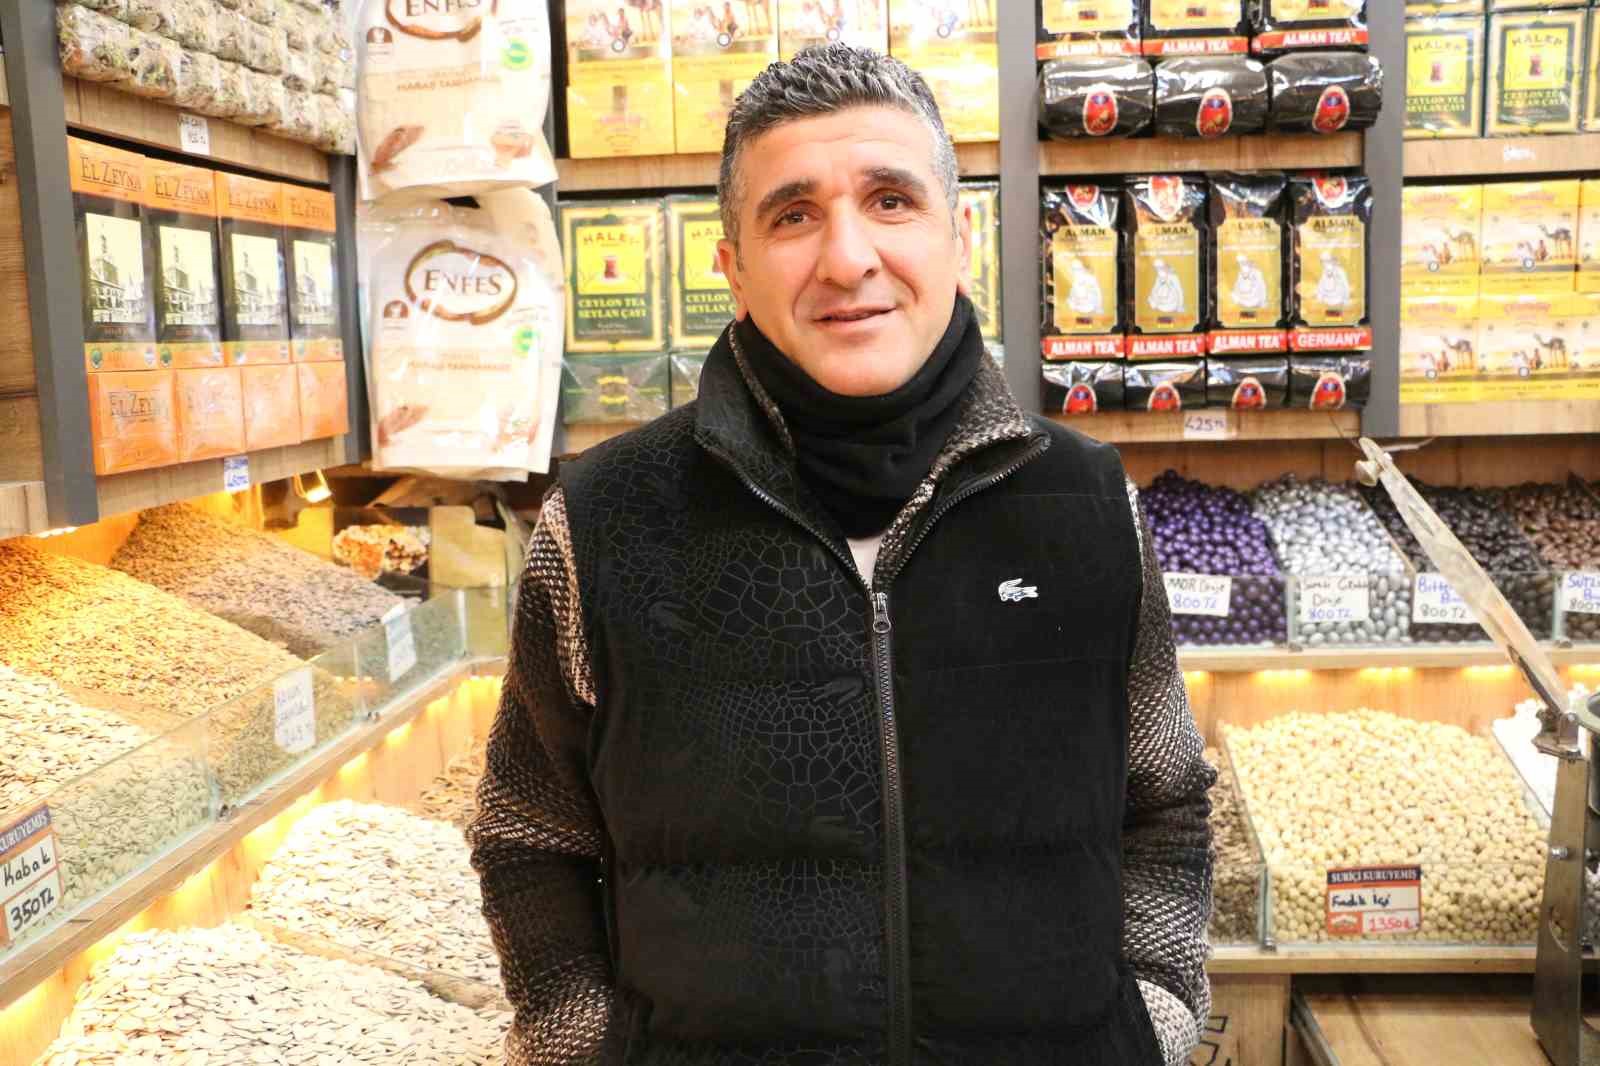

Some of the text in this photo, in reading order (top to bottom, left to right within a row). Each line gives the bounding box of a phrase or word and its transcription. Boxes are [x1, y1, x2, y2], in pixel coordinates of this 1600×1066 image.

[1283, 31, 1351, 47] ALMAN TEA
[1098, 40, 1122, 55] TEA
[1161, 39, 1229, 55] ALMAN TEA
[1147, 226, 1189, 236] LMAN
[424, 269, 502, 296] ENFES
[578, 297, 646, 309] CEYLON TEA
[577, 309, 620, 319] SEYLAN
[1132, 339, 1198, 354] ALMAN TEA
[1214, 334, 1281, 349] ALMAN TEA
[1297, 332, 1361, 347] GERMANY
[1051, 341, 1117, 354] ALMAN TEA
[4, 847, 51, 887] Kabak
